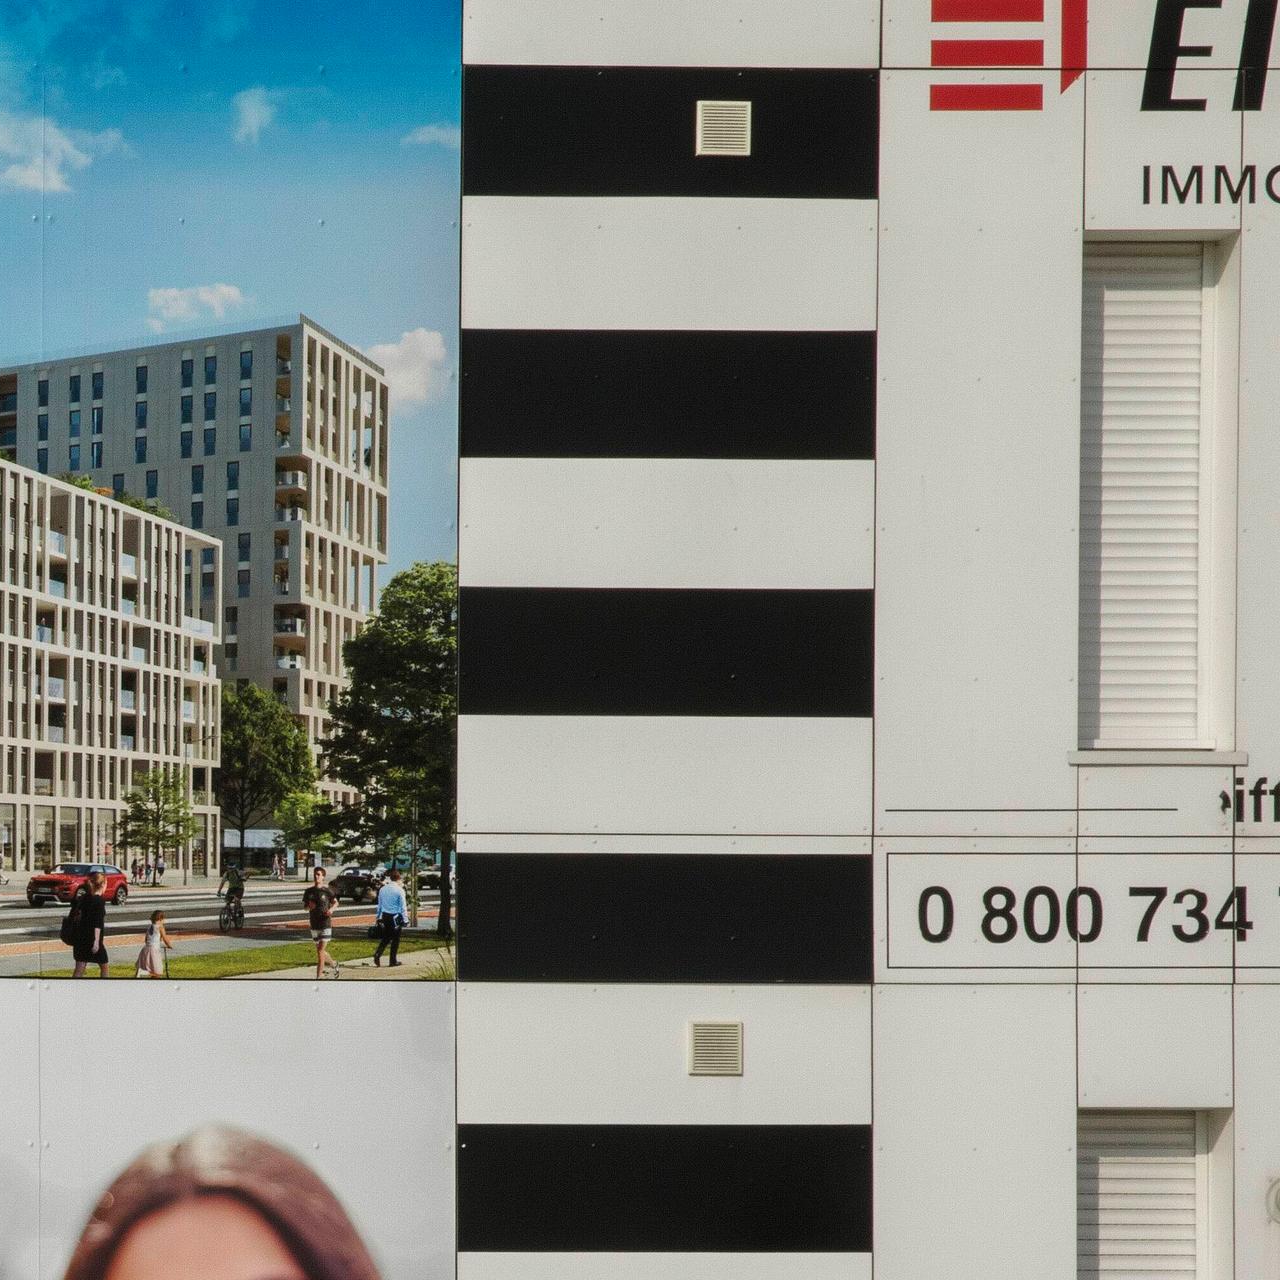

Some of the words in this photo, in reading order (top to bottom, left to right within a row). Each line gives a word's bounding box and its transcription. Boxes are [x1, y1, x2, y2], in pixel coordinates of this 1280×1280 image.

[918, 886, 954, 943] 0
[981, 886, 1104, 943] 800
[1128, 886, 1254, 943] 734
